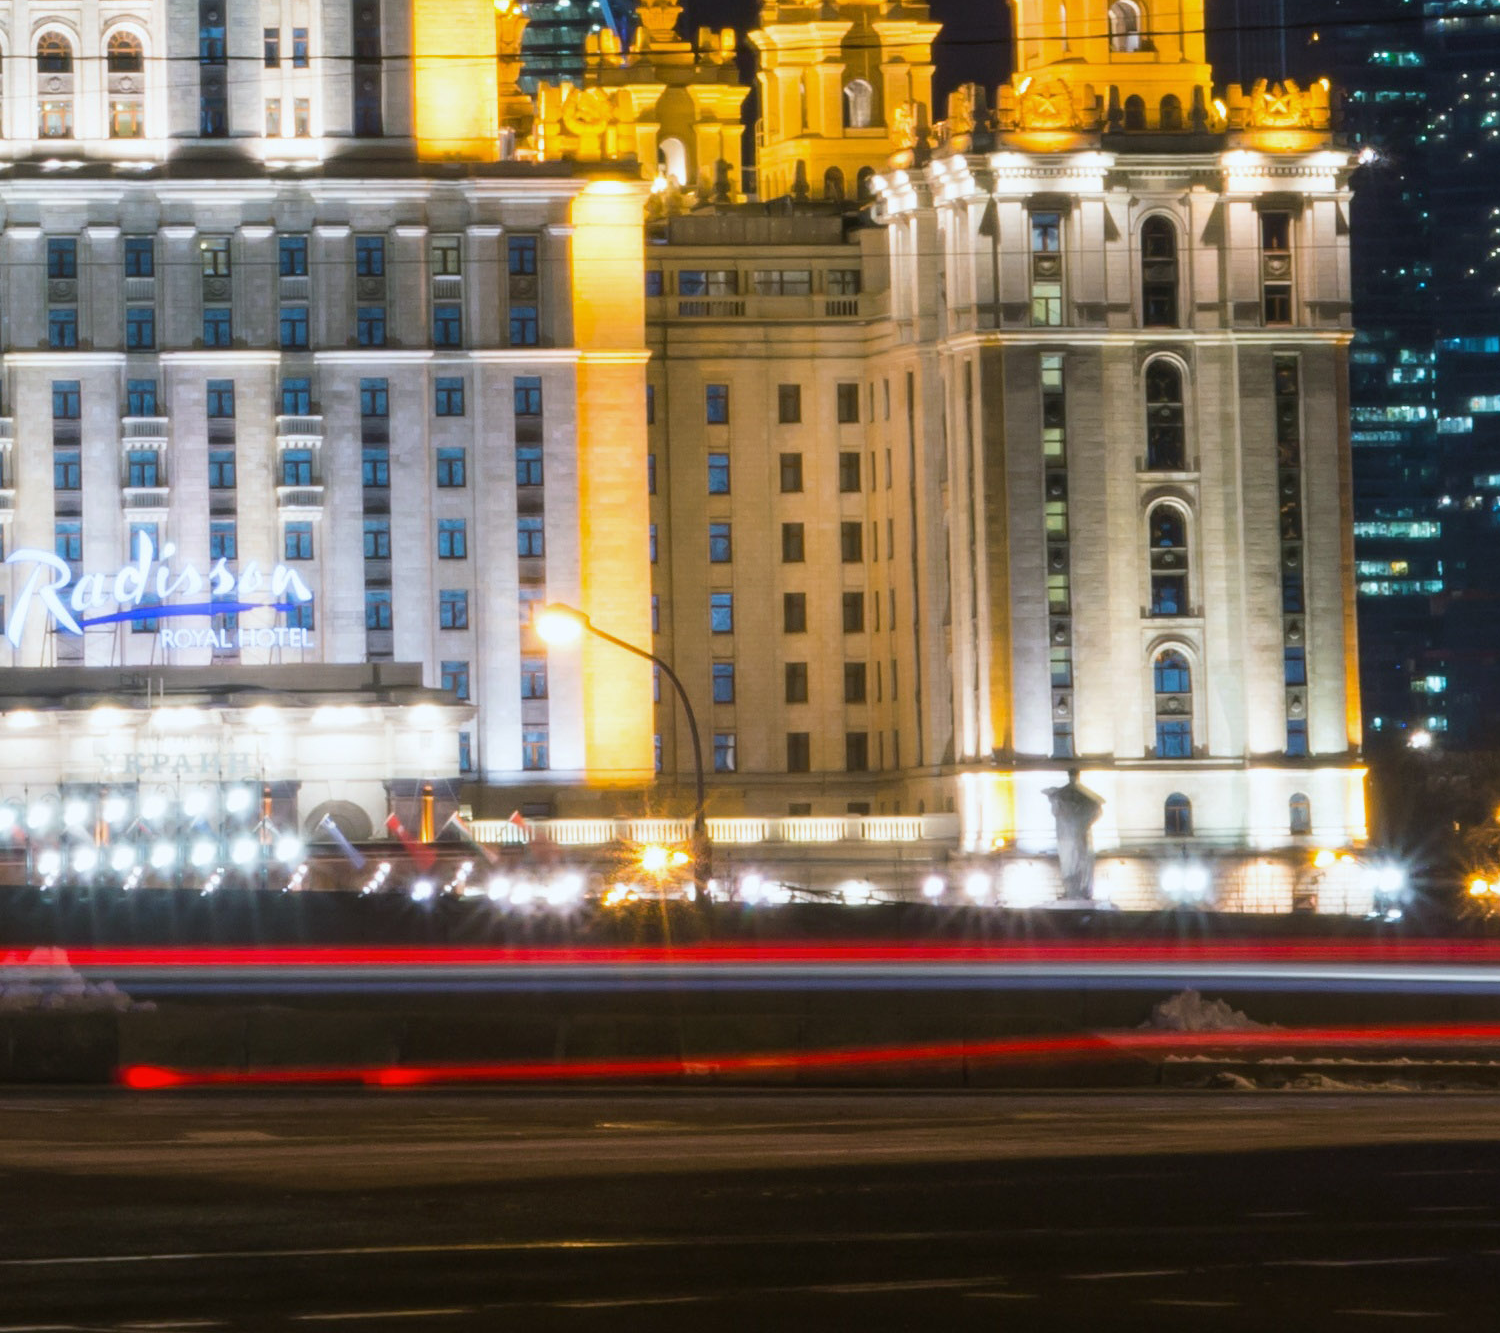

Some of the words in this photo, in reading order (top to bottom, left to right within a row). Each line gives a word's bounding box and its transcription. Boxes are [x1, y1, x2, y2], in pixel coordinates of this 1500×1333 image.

[4, 529, 313, 649] Radisson
[161, 629, 233, 649] ROYAL
[238, 628, 314, 648] HOTEL
